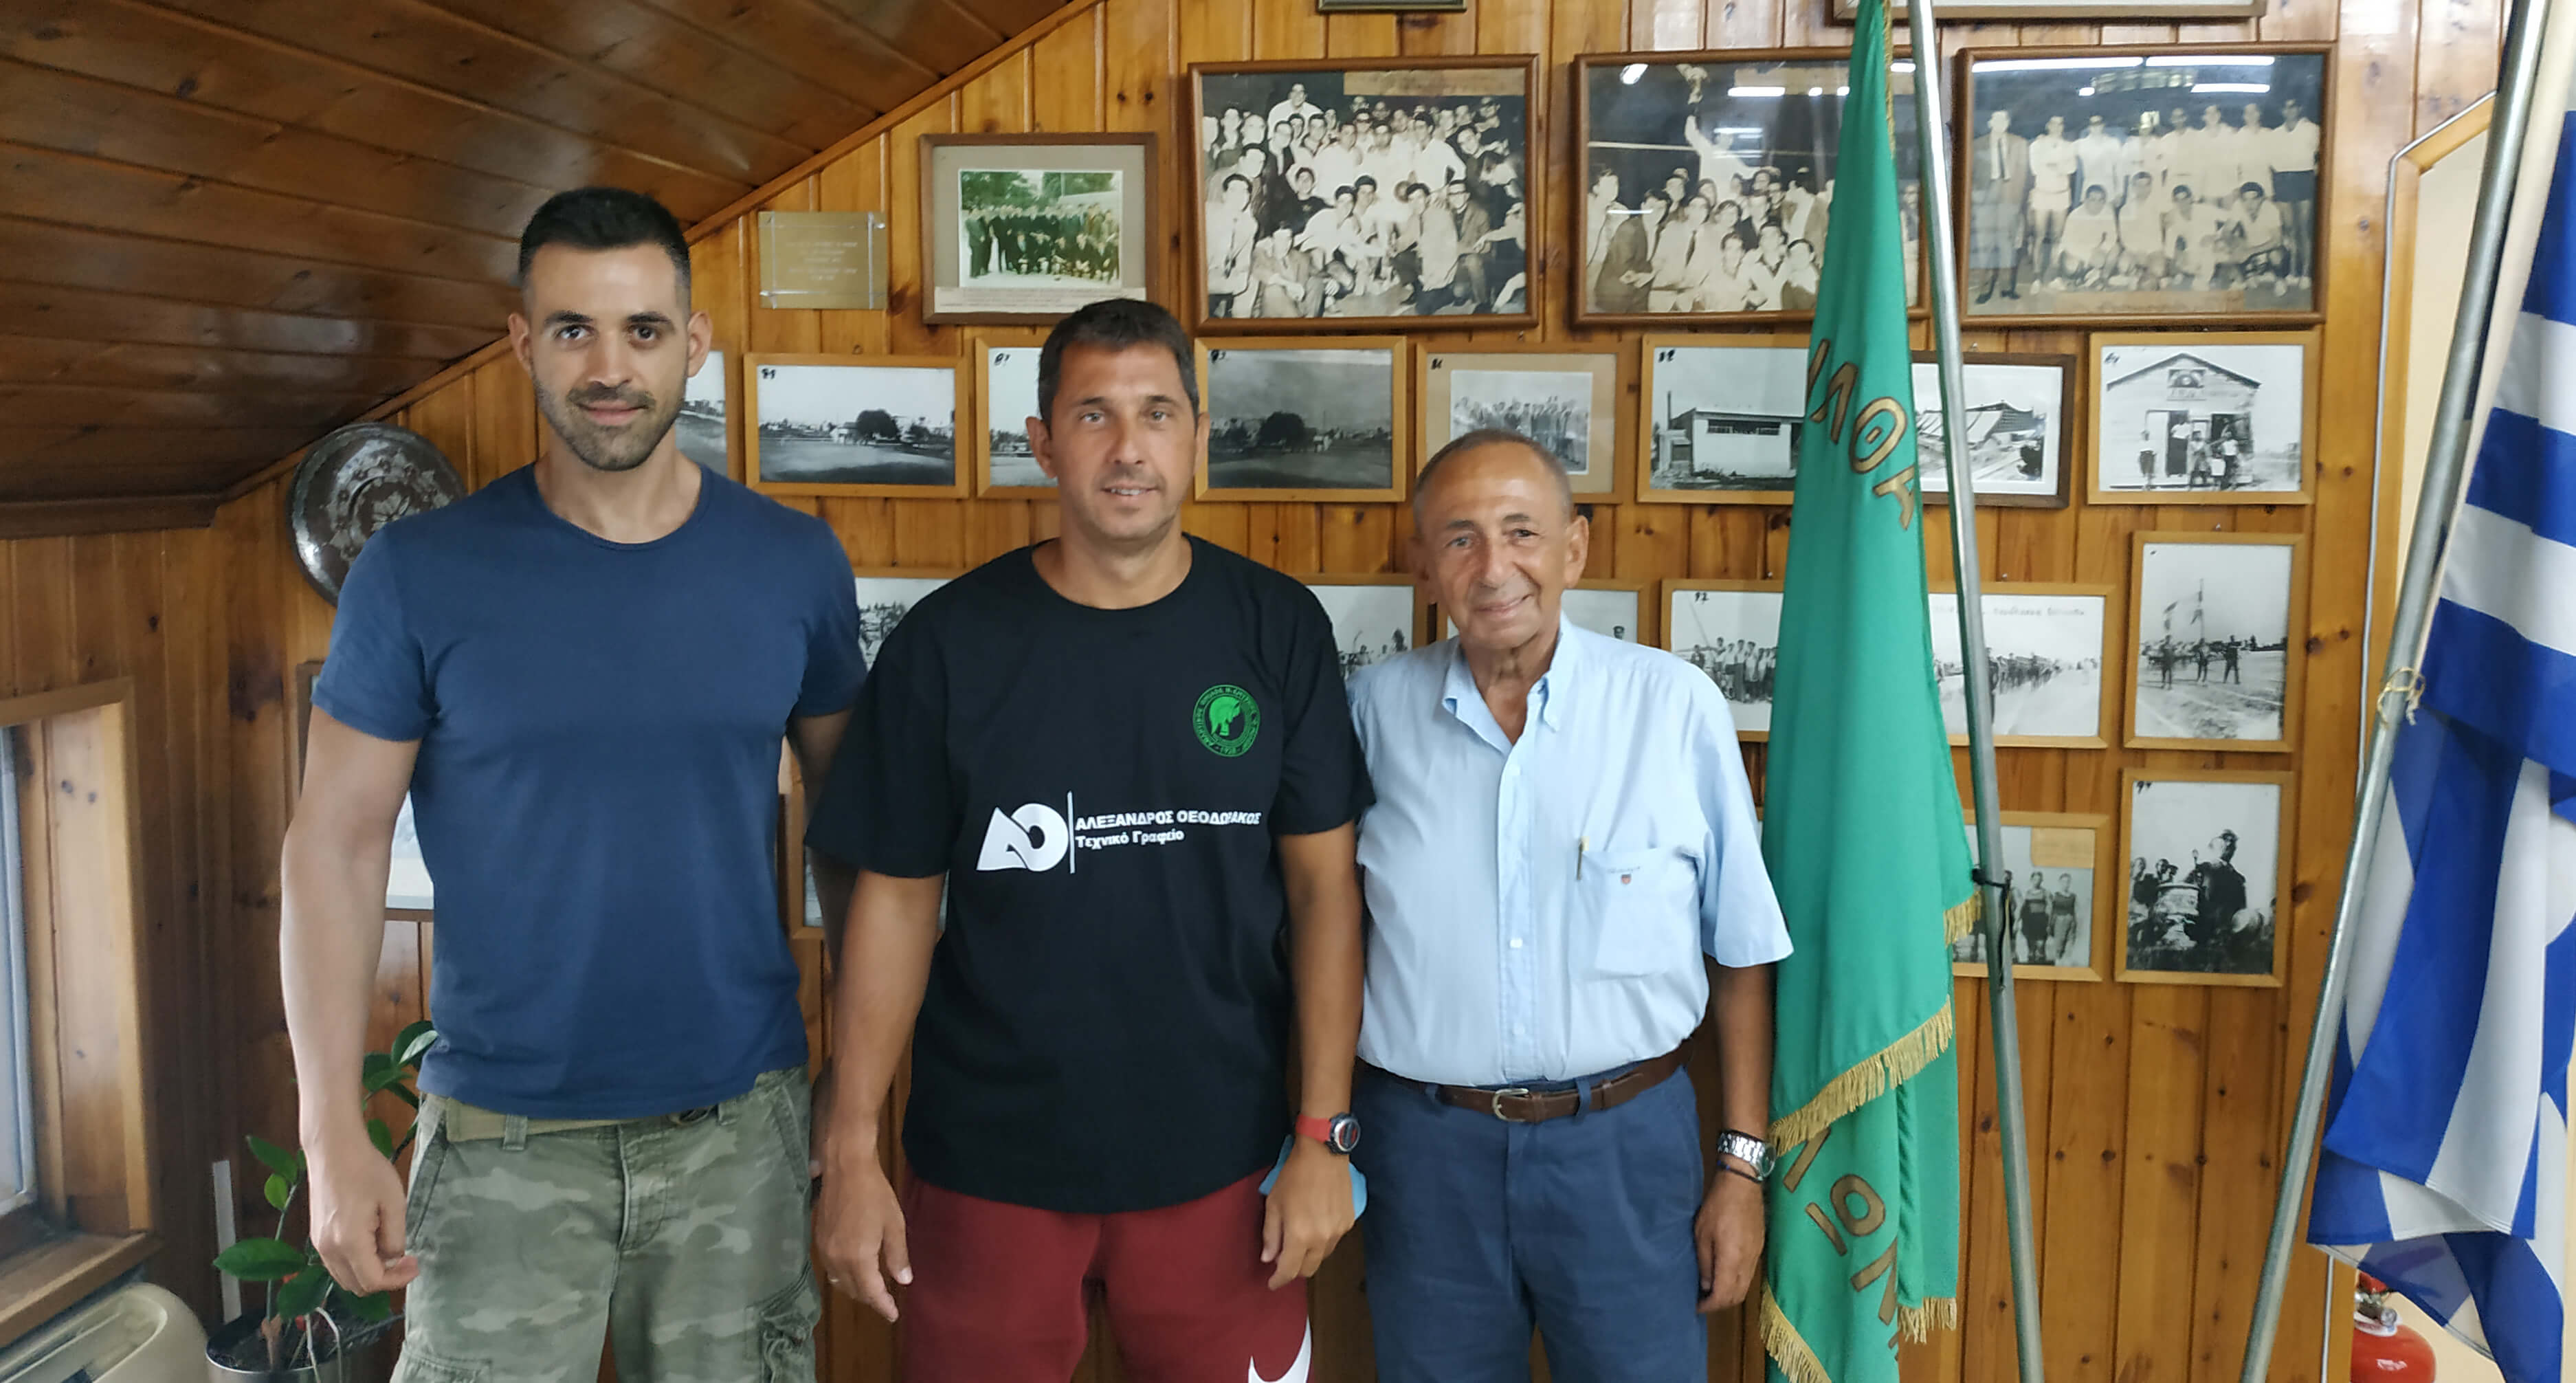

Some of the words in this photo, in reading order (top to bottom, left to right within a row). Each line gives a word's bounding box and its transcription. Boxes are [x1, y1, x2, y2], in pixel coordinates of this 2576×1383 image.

[1075, 811, 1174, 830] ΑΛΕΞΑΝΔΡΟΣ
[1075, 832, 1130, 850] Τεχνικό
[1132, 828, 1185, 845] Γραφείο
